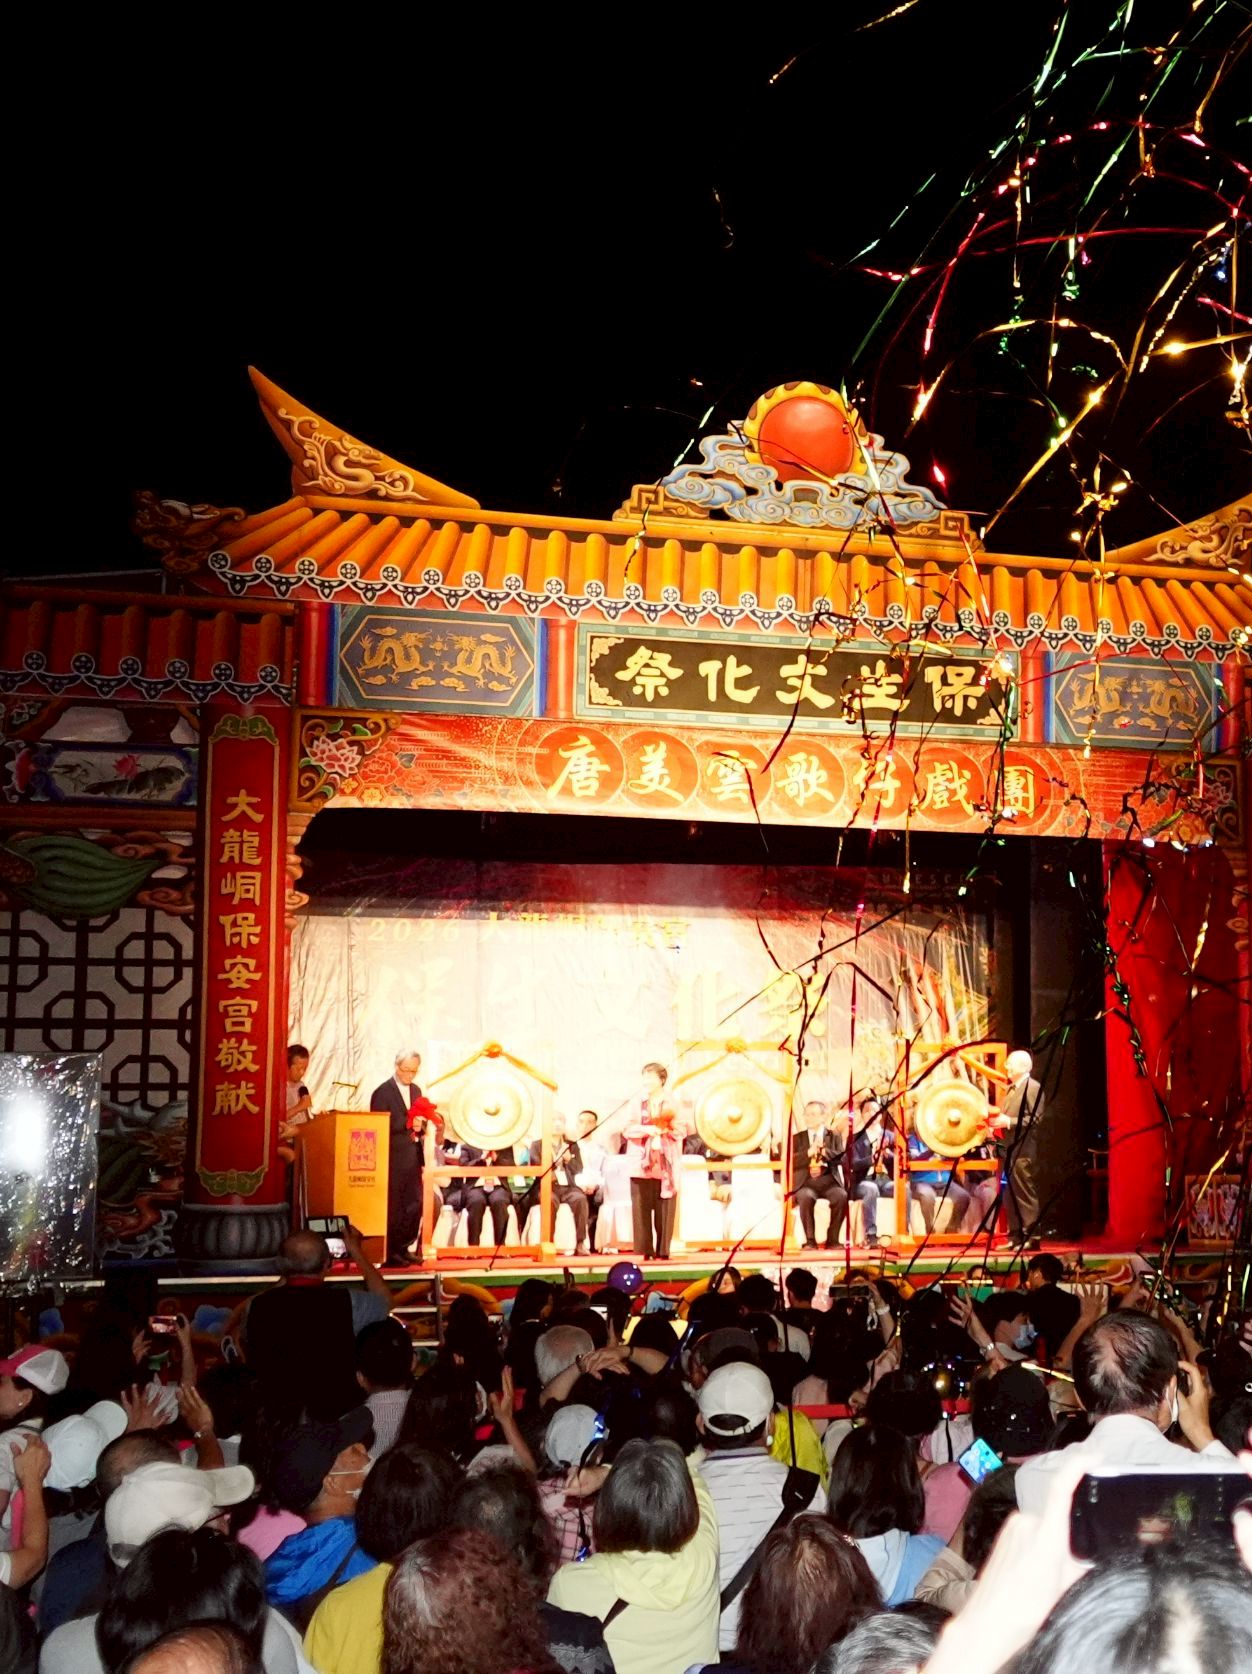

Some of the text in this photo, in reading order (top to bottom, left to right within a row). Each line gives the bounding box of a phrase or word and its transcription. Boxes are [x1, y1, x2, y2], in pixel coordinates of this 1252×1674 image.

[547, 735, 1036, 817] 唐美雲歌仔戲團
[369, 918, 461, 942] 2026
